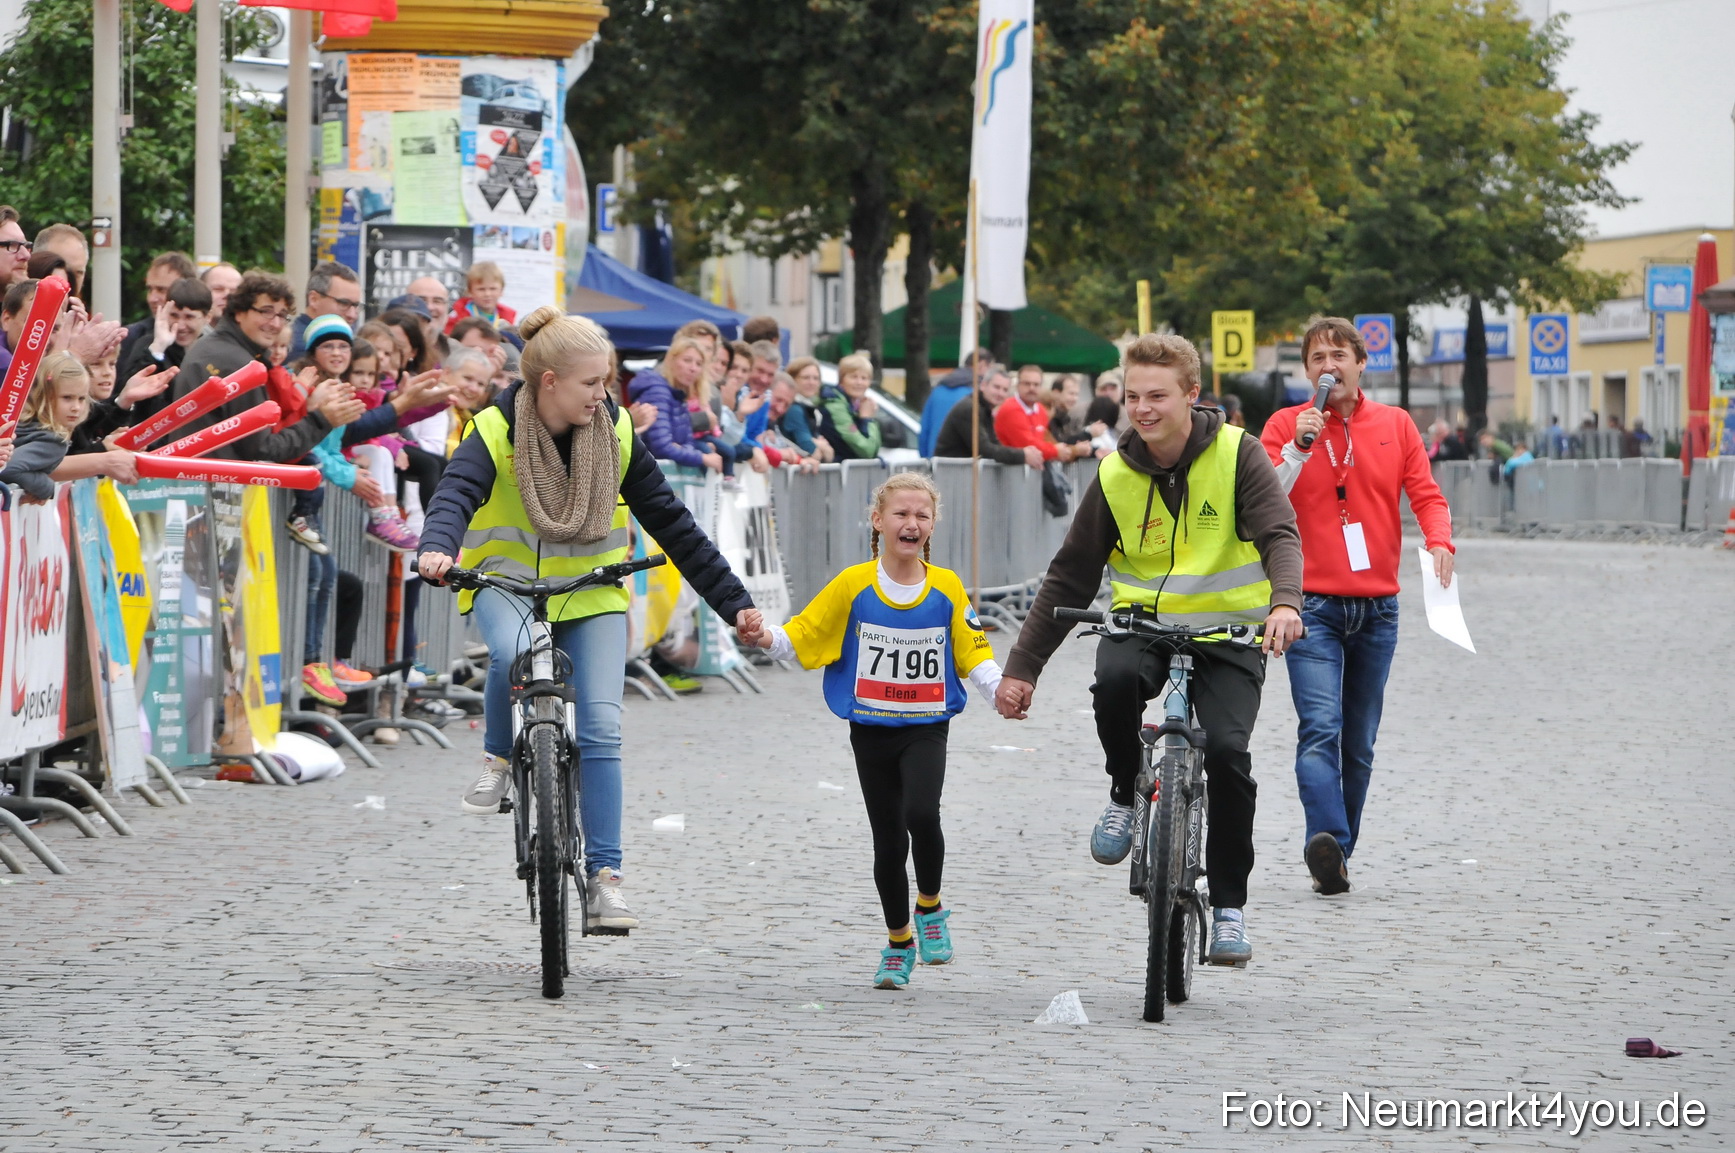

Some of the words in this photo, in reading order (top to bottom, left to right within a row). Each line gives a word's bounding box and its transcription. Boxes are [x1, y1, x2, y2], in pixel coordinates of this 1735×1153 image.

[374, 249, 463, 269] GLENN
[1217, 315, 1248, 325] Block
[1224, 331, 1243, 357] D
[1532, 356, 1567, 370] TAXI
[1, 391, 20, 423] Audi
[13, 361, 31, 389] BKK
[133, 427, 153, 445] Audi
[153, 415, 173, 431] BKK
[153, 444, 176, 456] udi
[178, 433, 204, 450] BKK
[1325, 439, 1337, 467] NISSAN
[211, 474, 239, 482] BKK
[862, 631, 890, 644] PARTL
[892, 637, 932, 646] Neumarkt
[868, 645, 939, 680] 7196
[885, 686, 917, 699] Elena
[853, 708, 944, 718] www.stadtlauf-neumarkt.de
[1132, 797, 1145, 858] AXEL
[1186, 800, 1201, 860] AXEL
